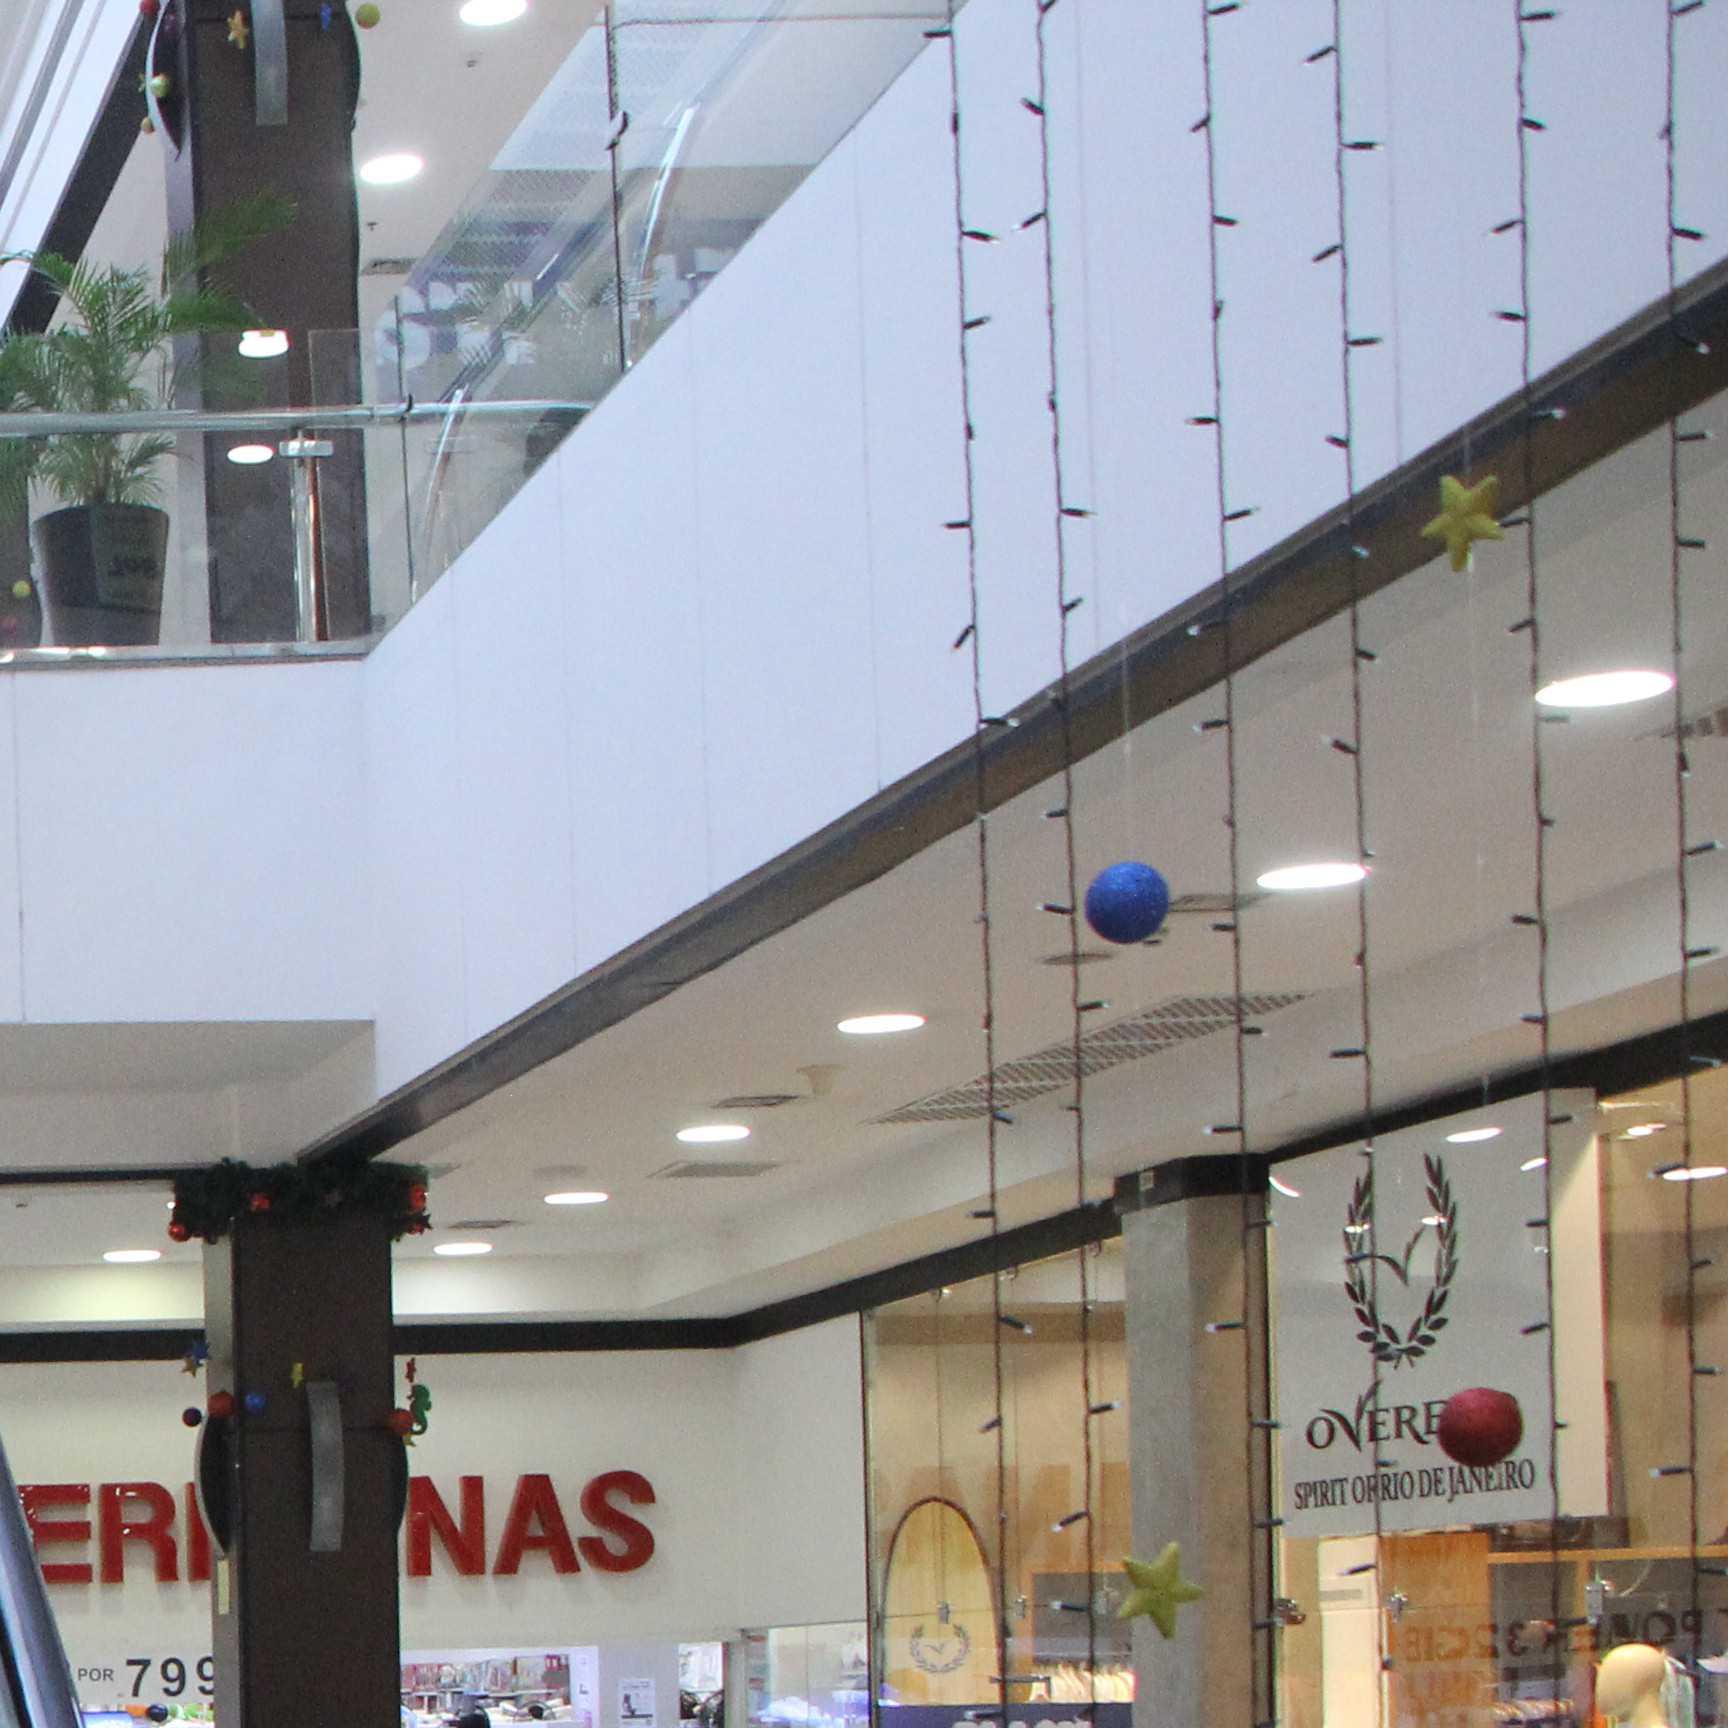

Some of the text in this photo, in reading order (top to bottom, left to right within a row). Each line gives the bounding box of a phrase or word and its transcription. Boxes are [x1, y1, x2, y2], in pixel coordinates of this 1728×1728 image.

[1305, 1380, 1448, 1452] OVERE
[1294, 1477, 1347, 1510] SPIRIT
[1380, 1470, 1414, 1502] RIO
[1419, 1467, 1445, 1498] DE
[1446, 1457, 1536, 1503] JANEIRO
[77, 1667, 115, 1691] POR
